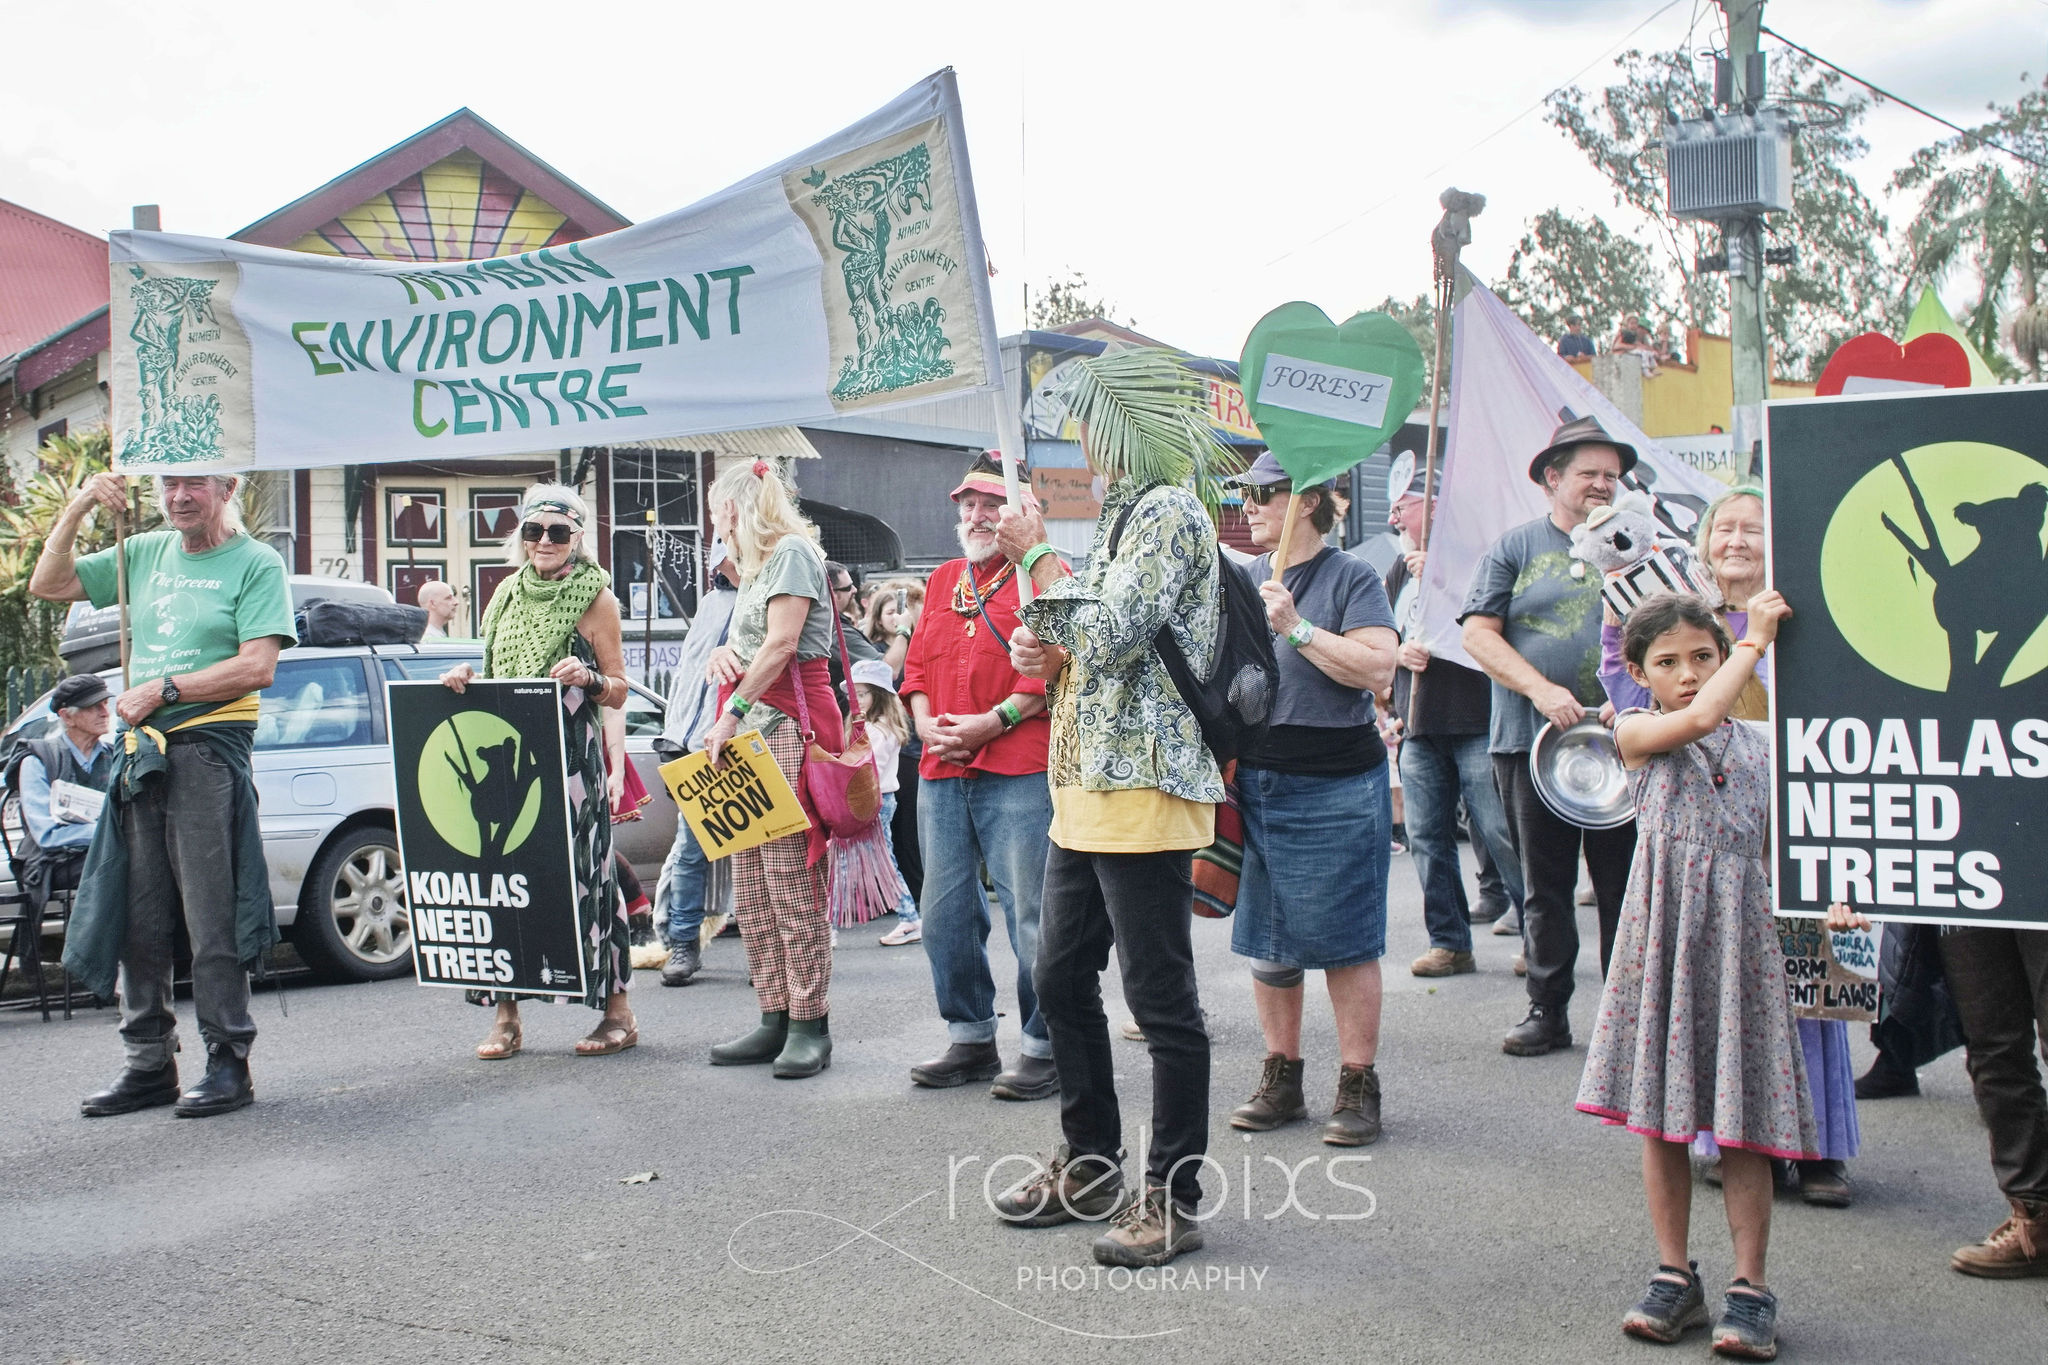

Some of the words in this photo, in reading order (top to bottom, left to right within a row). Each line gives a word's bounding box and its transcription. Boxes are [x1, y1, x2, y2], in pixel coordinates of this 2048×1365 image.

[897, 219, 931, 240] NIMBIN
[378, 243, 614, 305] NIMBIN
[881, 249, 958, 292] ENVIRONMENT
[905, 275, 936, 294] CENTRE
[188, 328, 221, 343] NIMBIN
[292, 265, 755, 376] ENVIRONMENT
[174, 352, 239, 382] ENVIRONMENT
[191, 376, 218, 386] CENTRE
[1266, 366, 1384, 402] FOREST
[413, 363, 648, 437] CENTRE
[151, 570, 171, 587] The
[174, 574, 222, 590] Greens
[319, 557, 350, 580] 72
[161, 662, 194, 676] future
[171, 648, 201, 660] Green
[514, 687, 552, 695] nature.org.au
[1786, 717, 2048, 779] KOALAS
[699, 760, 757, 814] ACTION
[701, 777, 775, 848] NOW
[1787, 781, 1961, 841] NEED
[410, 871, 530, 908] KOALAS
[1789, 845, 2003, 910] TREES
[415, 908, 493, 945] NEED
[1779, 933, 1822, 957] EST
[420, 945, 515, 983] TREES
[1823, 983, 1877, 1012] LAWS
